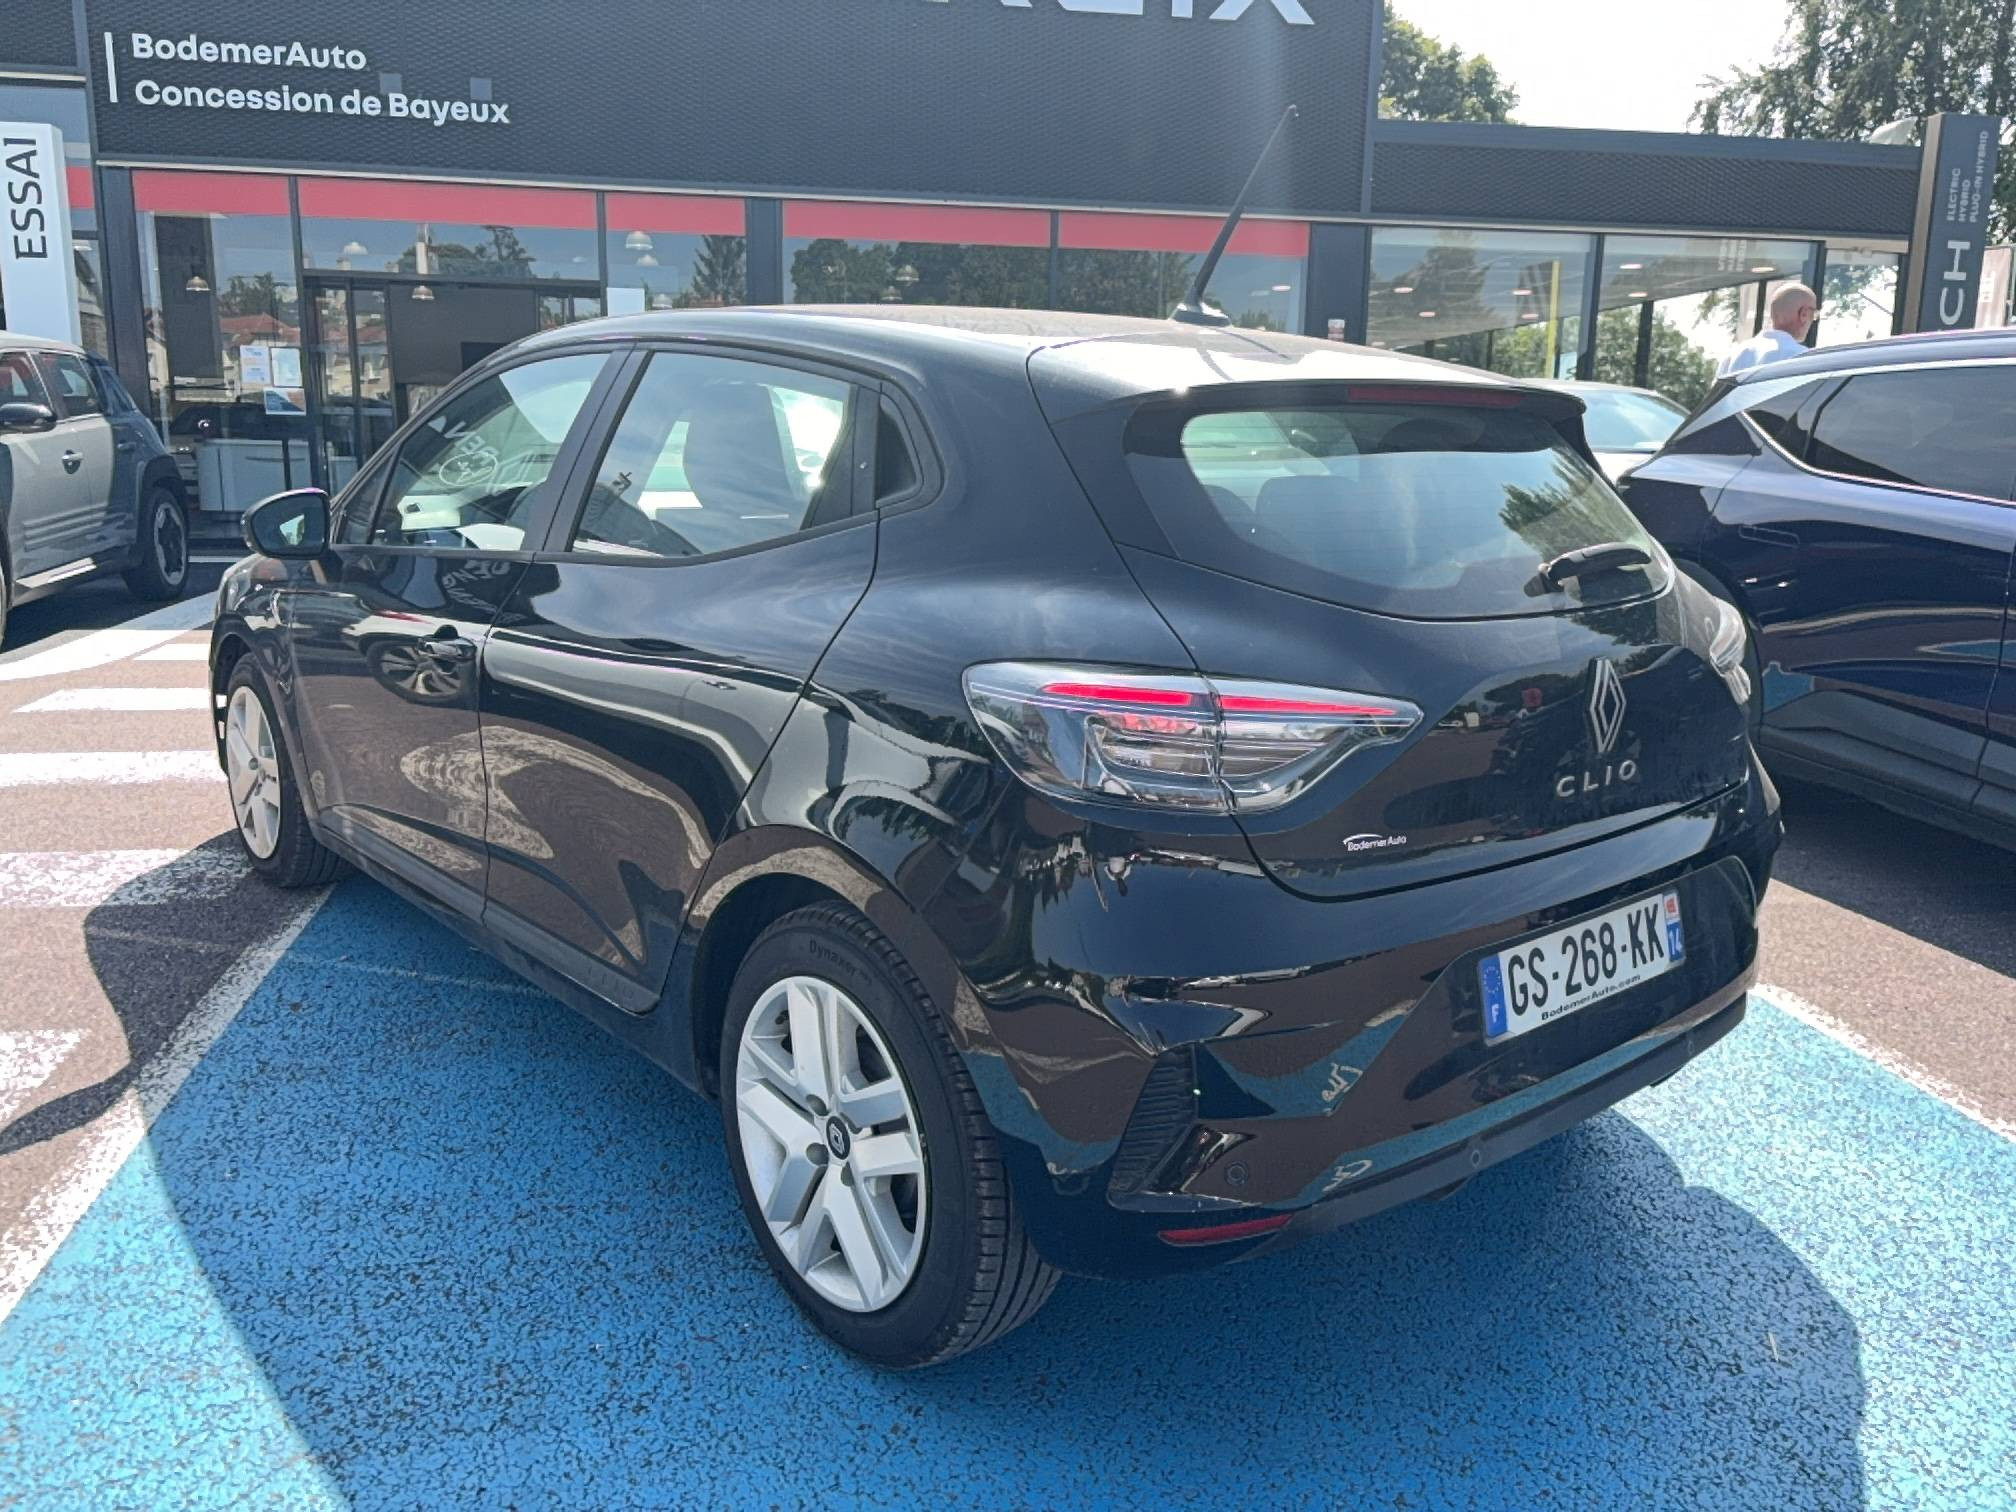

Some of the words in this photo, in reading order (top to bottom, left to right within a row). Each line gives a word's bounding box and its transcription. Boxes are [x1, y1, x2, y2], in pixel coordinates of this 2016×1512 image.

[131, 32, 367, 70] BodemerAuto
[135, 79, 334, 113] Concession
[340, 89, 382, 116] de
[388, 92, 511, 127] Bayeux
[3, 137, 48, 260] ESSAI
[1946, 167, 1961, 221] ELECTRIC
[1969, 175, 1983, 223] PLUG-IN
[1976, 130, 1989, 174] HYBRID
[1958, 179, 1971, 223] HYBRID
[1556, 760, 1637, 797] CLIO
[1508, 903, 1665, 1016] GS-268-KK
[1667, 927, 1683, 956] 14
[1491, 1003, 1500, 1023] F
[1541, 975, 1641, 1020] BodemerAuto.com
